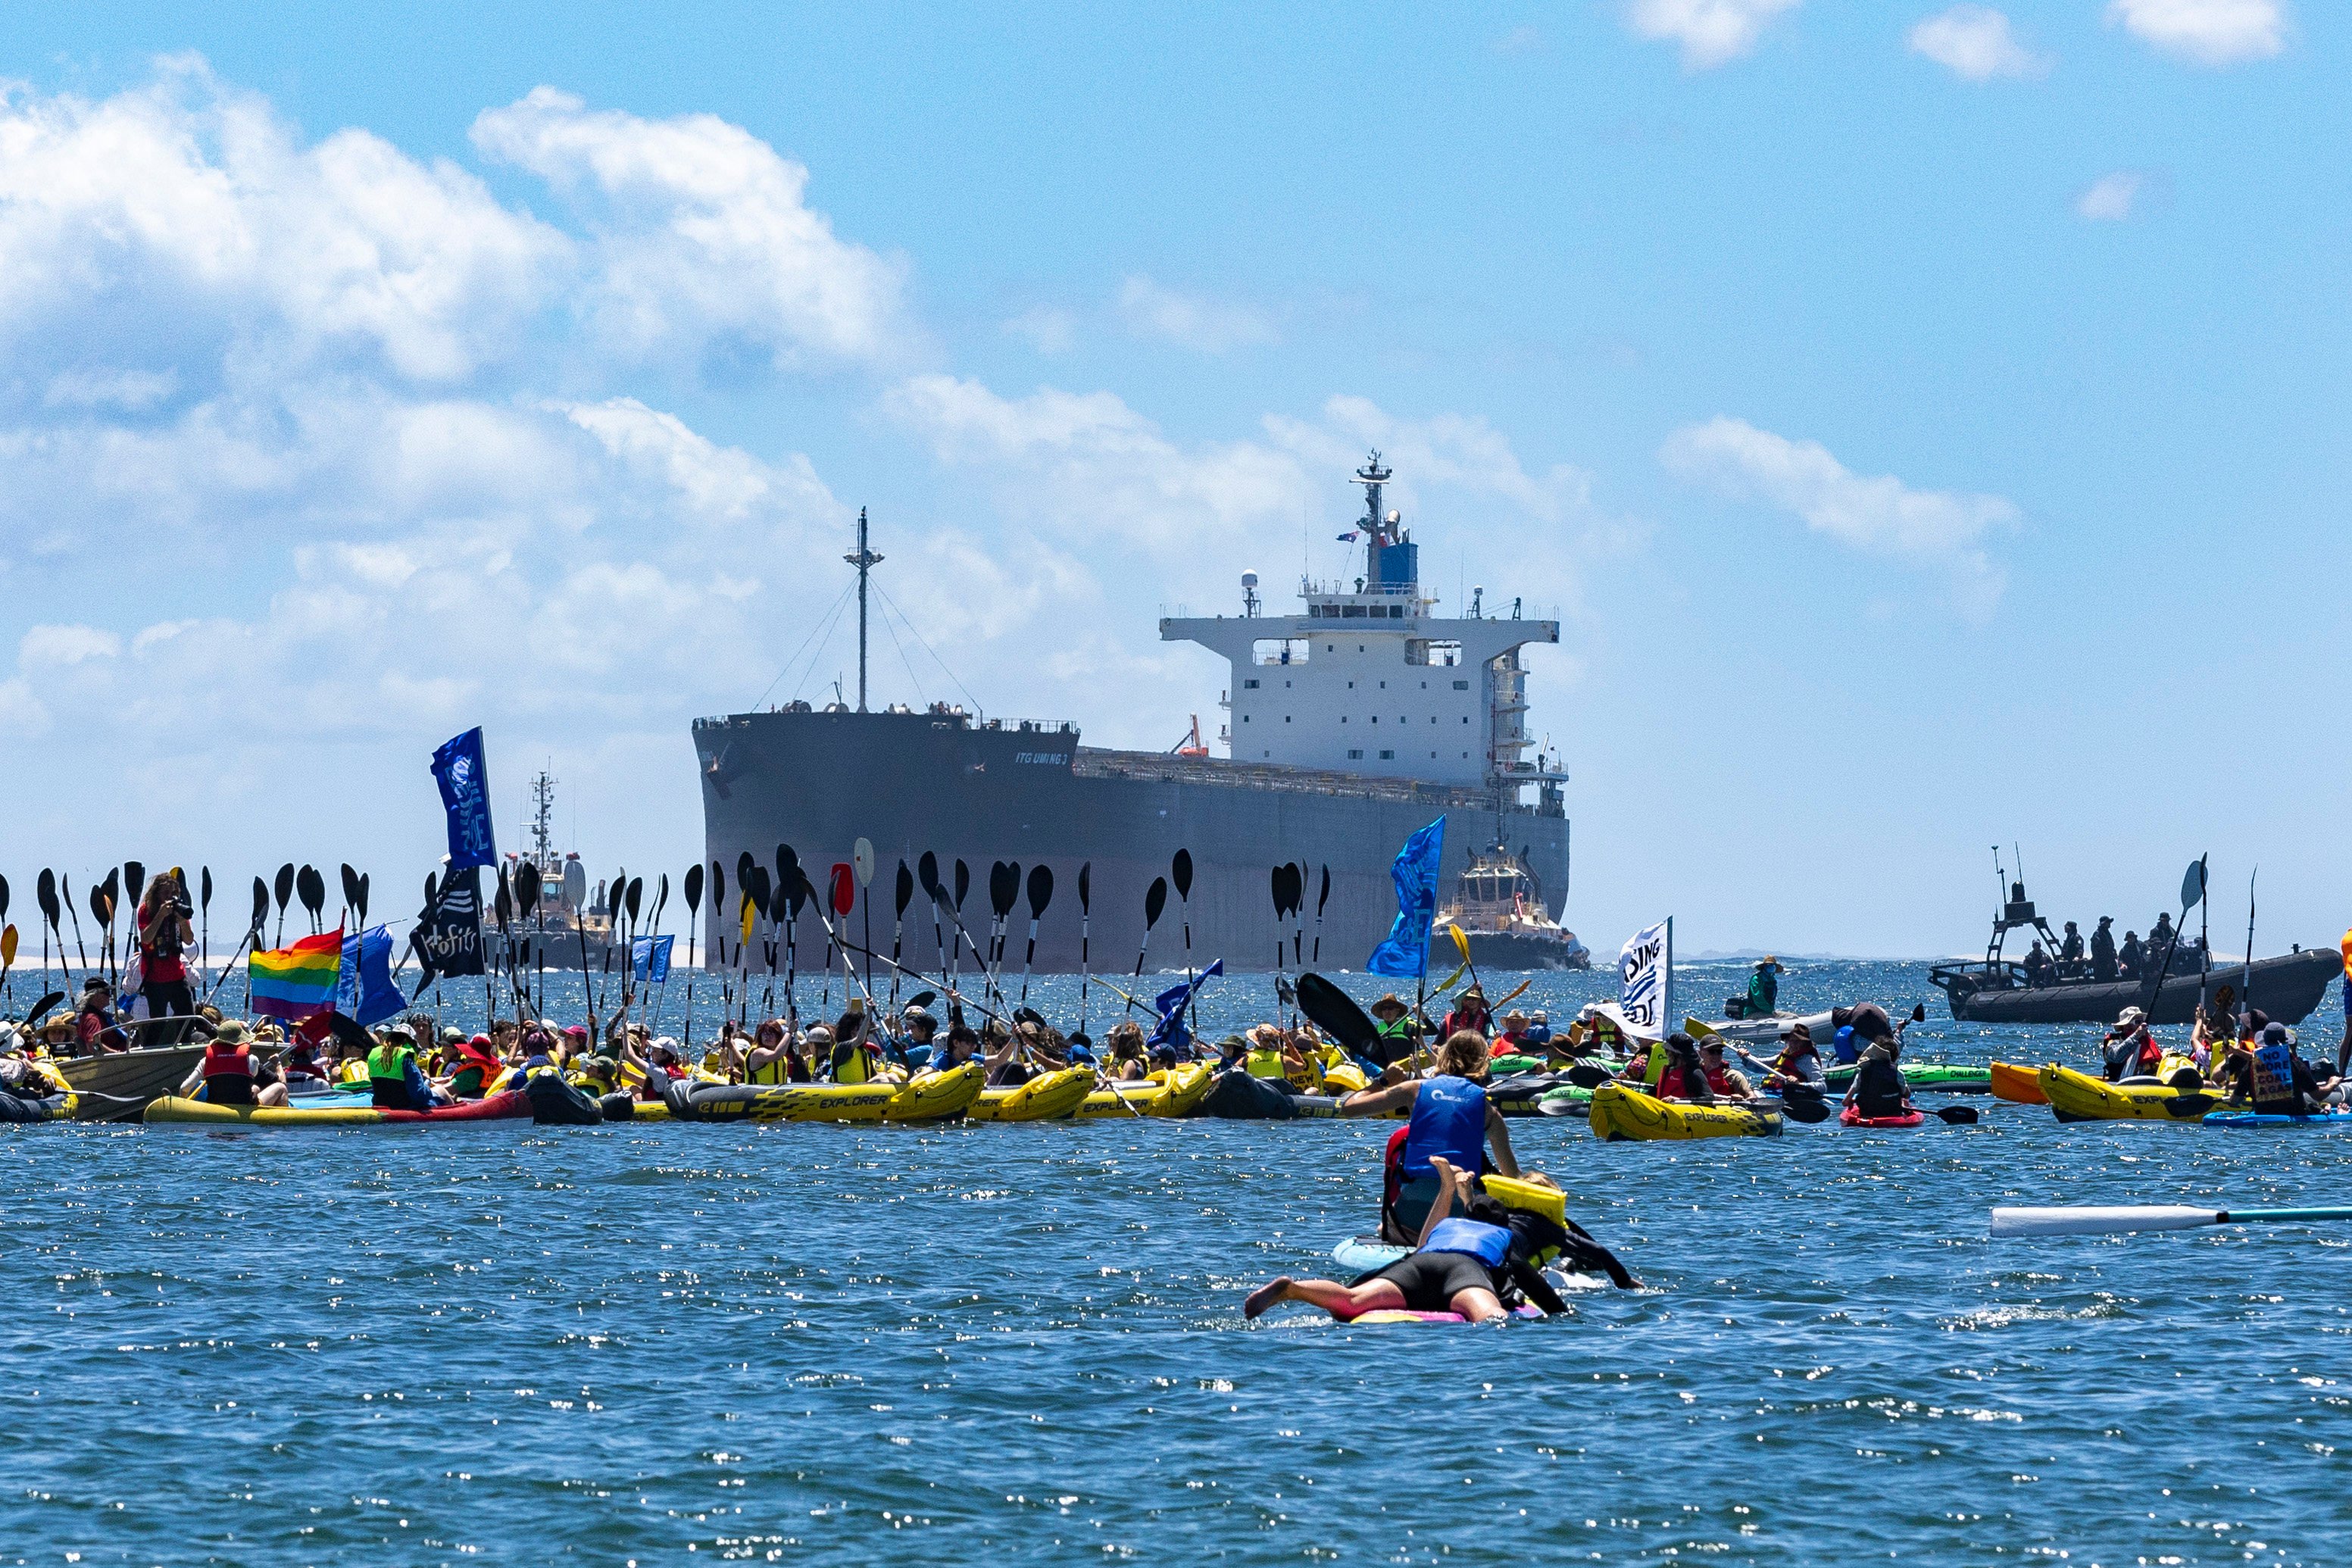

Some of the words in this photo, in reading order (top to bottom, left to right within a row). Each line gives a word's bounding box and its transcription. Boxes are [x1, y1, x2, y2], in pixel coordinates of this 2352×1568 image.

[1015, 752, 1032, 764] ITG
[2263, 1051, 2280, 1060] NO
[2257, 1060, 2290, 1073] MORE
[1291, 1073, 1314, 1085] NEW
[2258, 1072, 2291, 1084] COAL
[820, 1095, 889, 1110] EXPLORER
